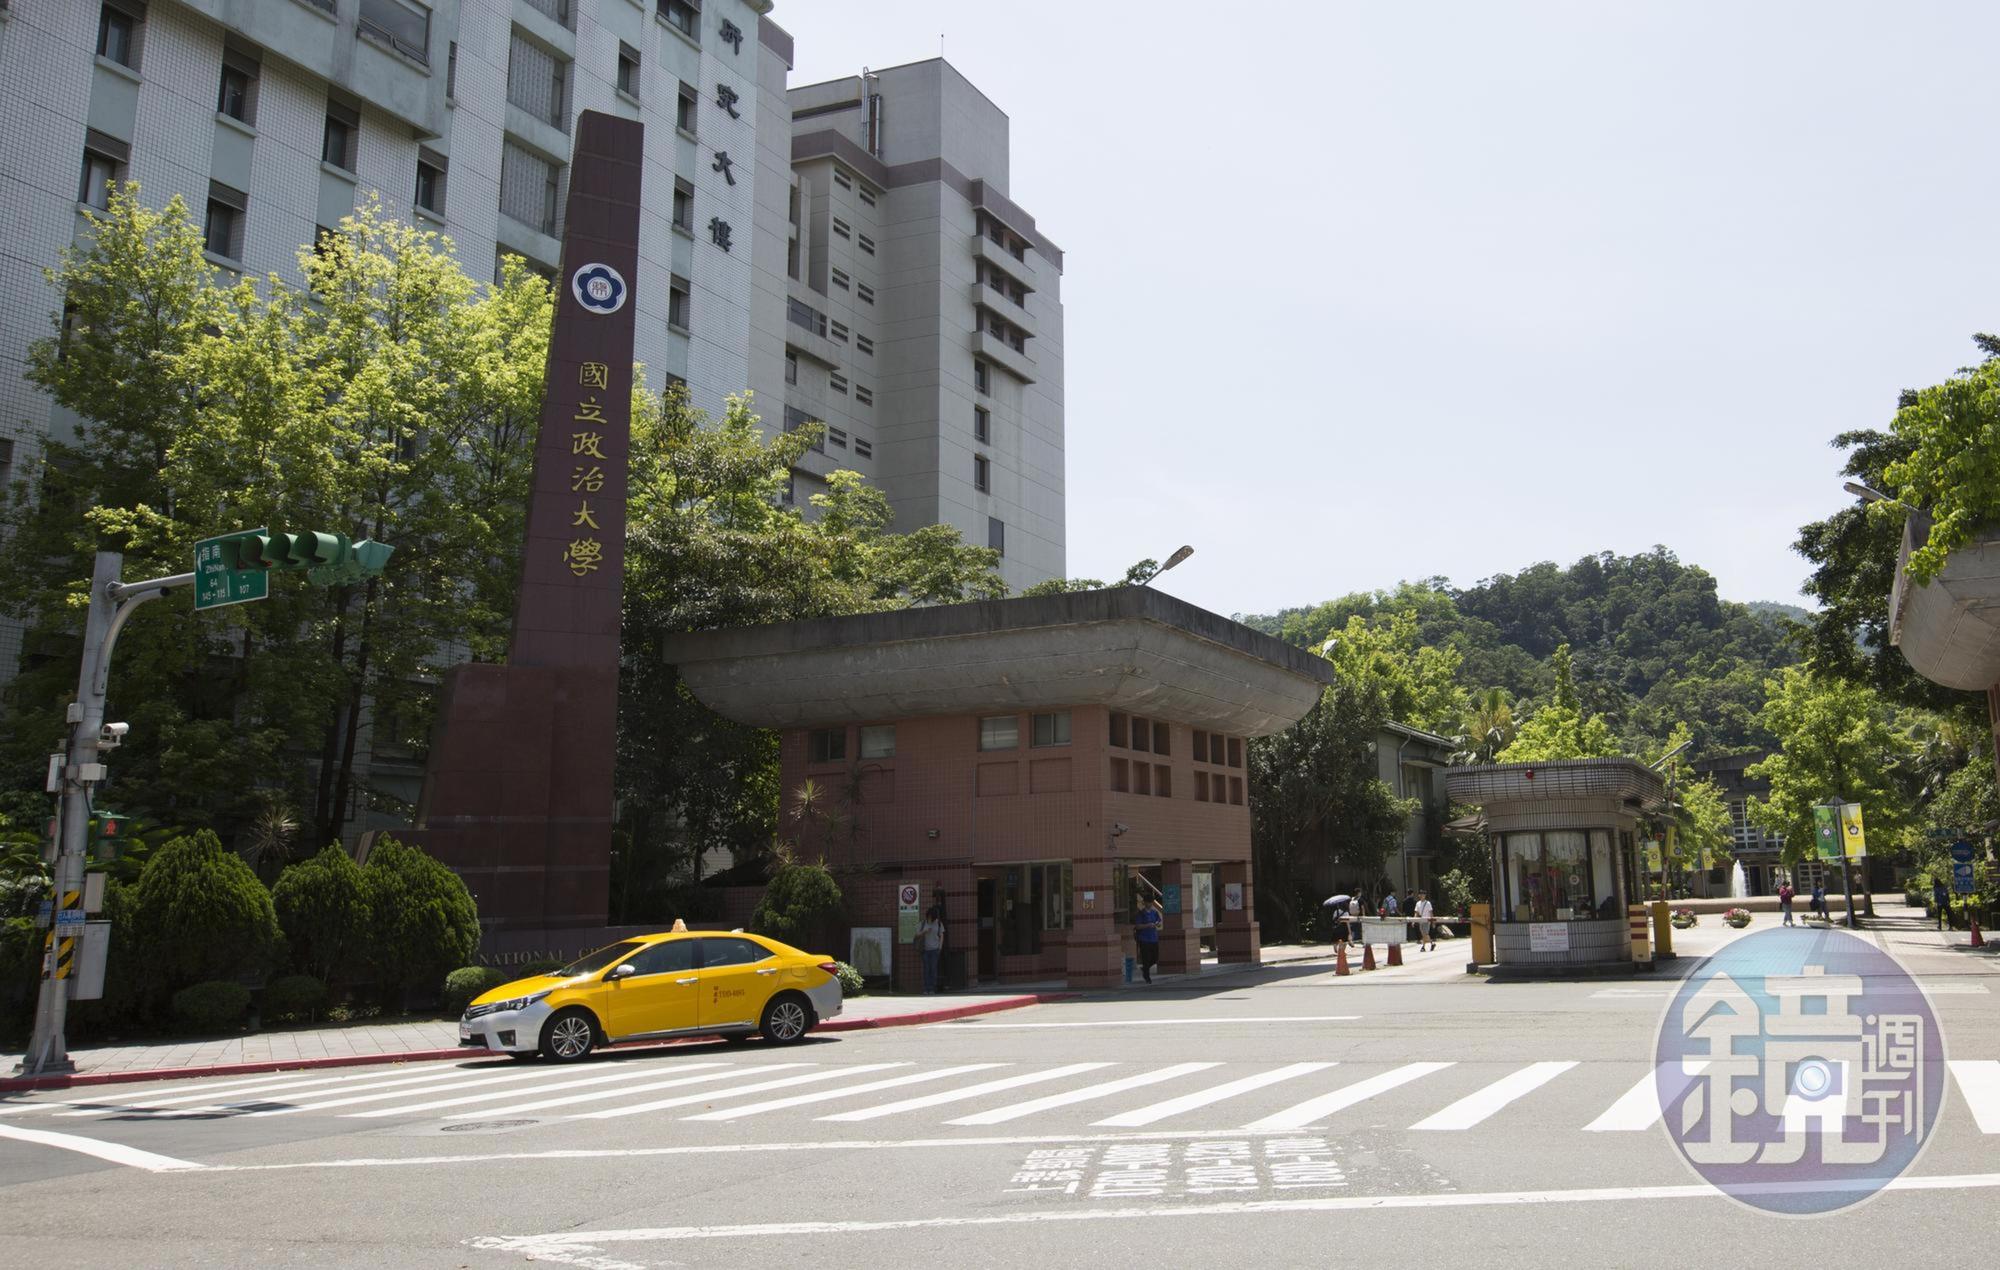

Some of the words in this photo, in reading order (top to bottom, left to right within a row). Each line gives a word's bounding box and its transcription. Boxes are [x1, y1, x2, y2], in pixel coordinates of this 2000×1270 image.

[708, 18, 744, 252] 研究大樓
[564, 361, 609, 577] 國立政治大學
[479, 949, 563, 966] NATIONAL
